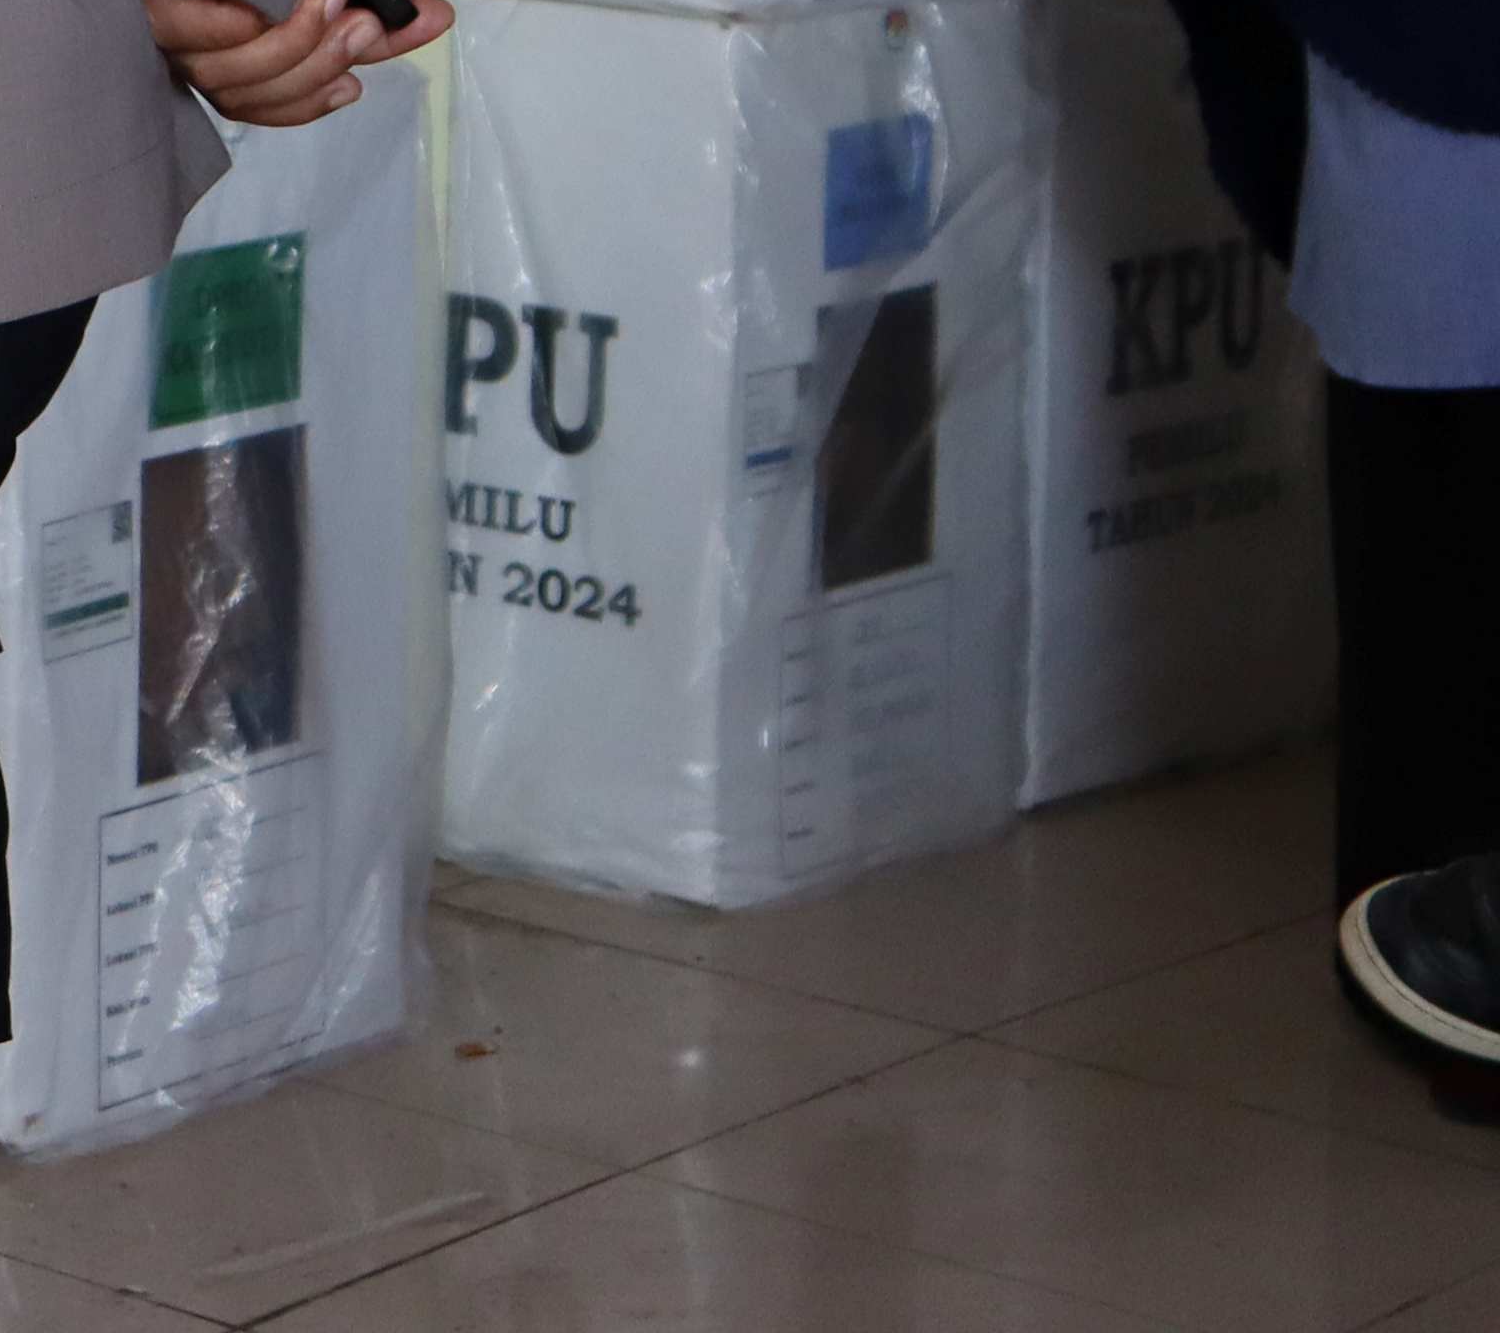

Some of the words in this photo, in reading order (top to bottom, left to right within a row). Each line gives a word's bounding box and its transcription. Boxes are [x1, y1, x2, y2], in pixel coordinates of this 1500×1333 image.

[1106, 237, 1265, 395] KPU
[444, 291, 620, 457] PU
[444, 479, 577, 543] MILU
[502, 561, 644, 627] 2024
